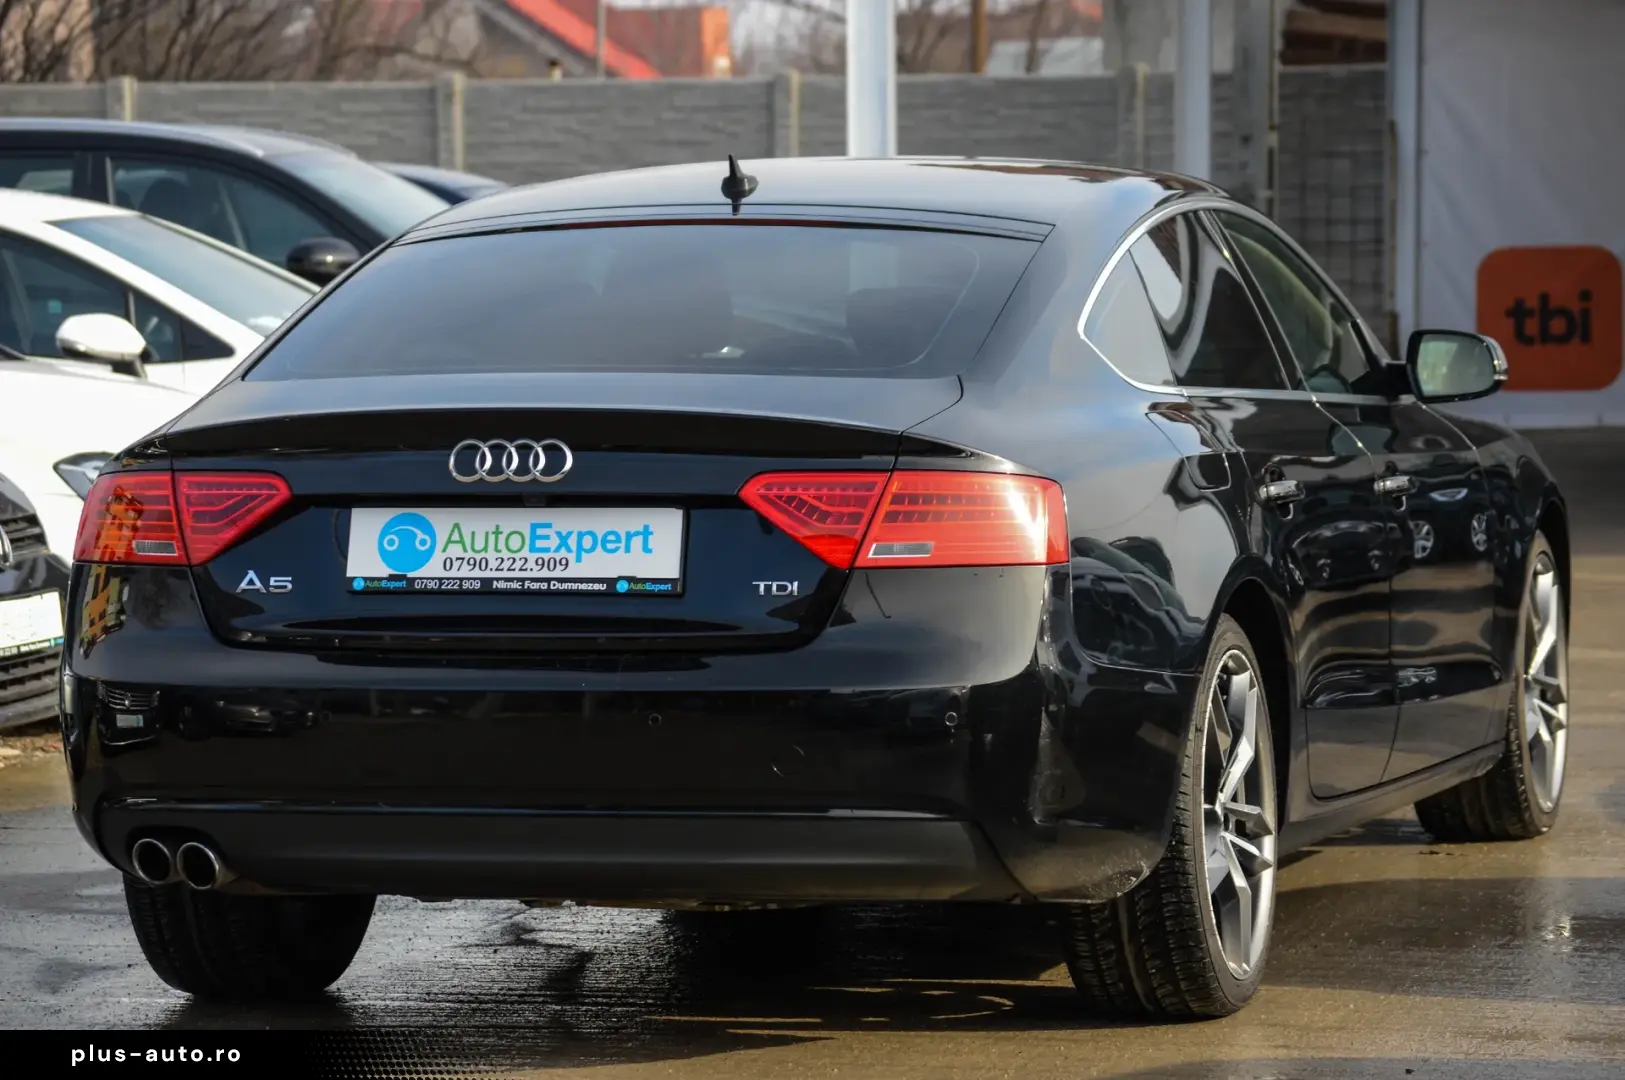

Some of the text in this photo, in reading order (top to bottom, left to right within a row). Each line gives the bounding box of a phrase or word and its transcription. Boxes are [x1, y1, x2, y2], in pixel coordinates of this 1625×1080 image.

[1504, 288, 1593, 346] tbi
[441, 522, 655, 564] AutoExpert
[442, 556, 570, 573] 0790.222.909
[235, 569, 293, 594] A5
[364, 579, 407, 590] AutoExpert
[414, 579, 481, 590] 0790 222 909
[492, 580, 607, 591] Nimic Fara Dumnezeu
[628, 581, 673, 592] AutoExpert
[751, 580, 799, 596] TDI
